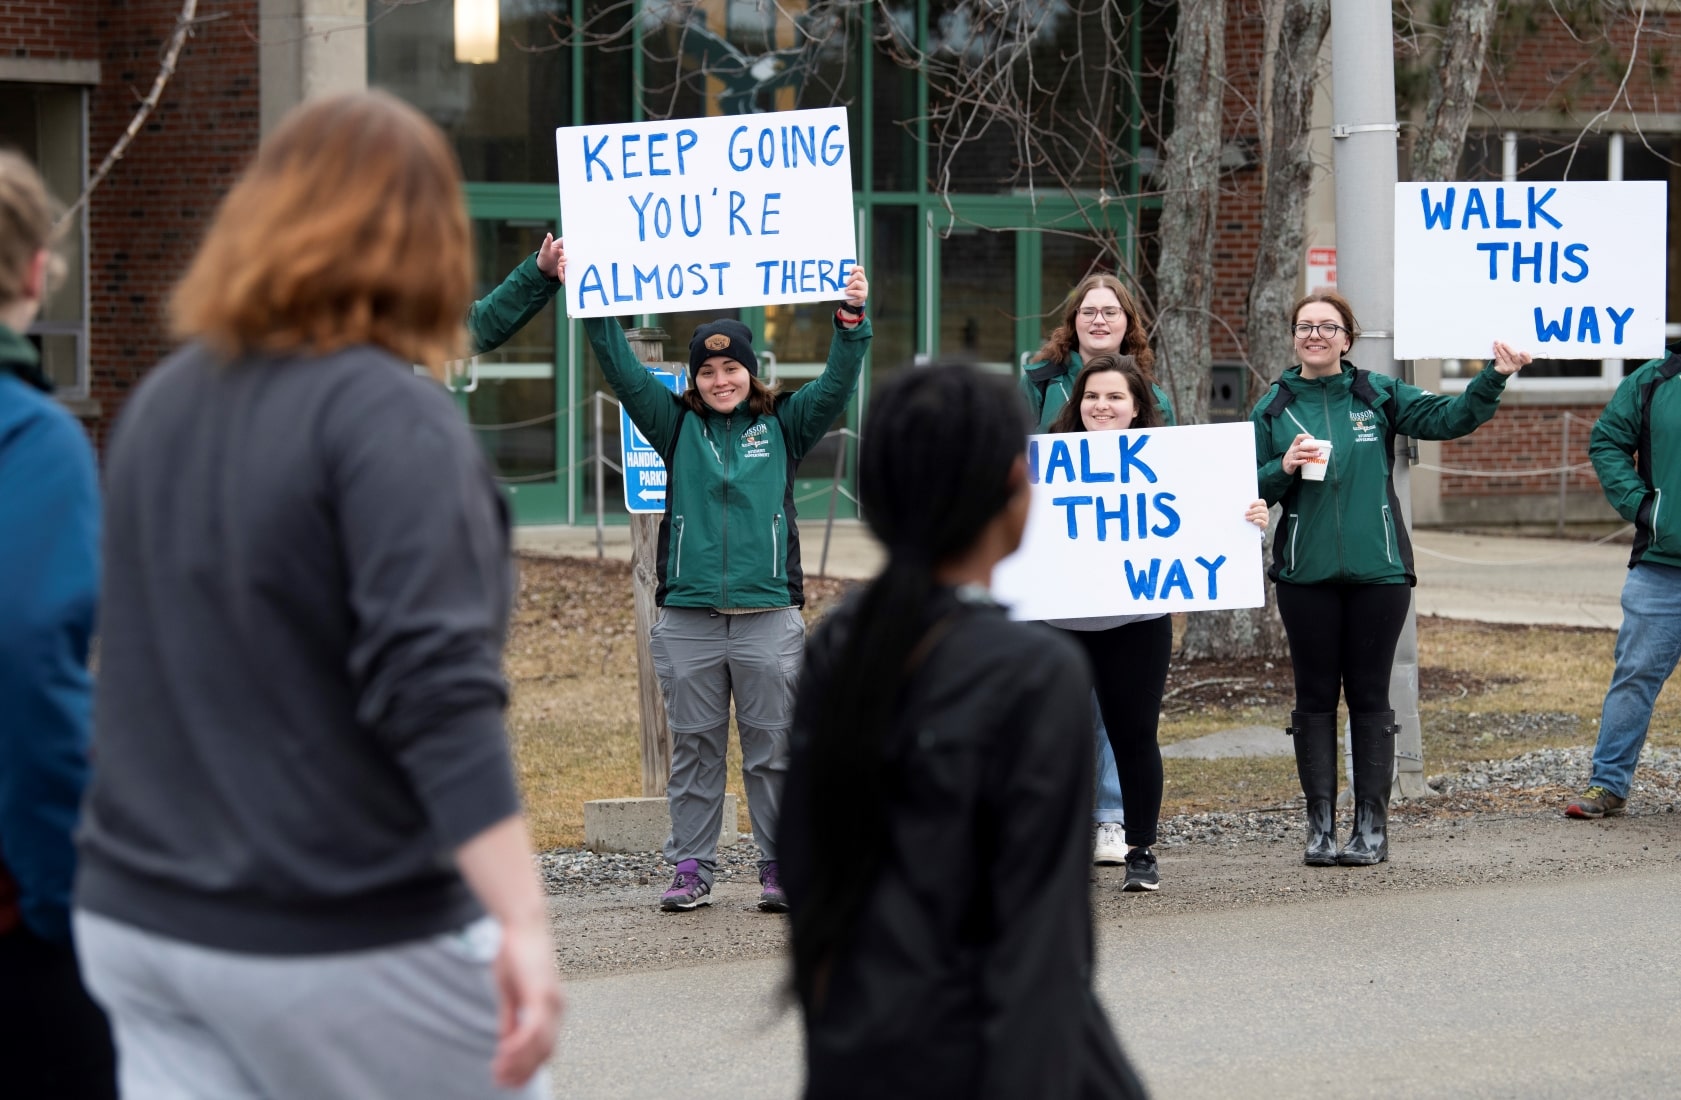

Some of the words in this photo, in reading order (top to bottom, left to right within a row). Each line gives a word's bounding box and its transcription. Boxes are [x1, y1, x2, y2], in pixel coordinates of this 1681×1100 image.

[582, 128, 699, 183] KEEP
[728, 124, 845, 172] GOING
[628, 187, 782, 242] YOU'RE
[1420, 186, 1563, 231] WALK
[578, 261, 731, 309] ALMOST
[755, 258, 857, 296] THERE
[1476, 241, 1590, 285] THIS
[1533, 305, 1635, 345] WAY
[626, 451, 666, 467] HANDICA
[639, 470, 667, 486] PARKI
[1051, 491, 1182, 542] THIS
[1123, 554, 1227, 601] WAY
